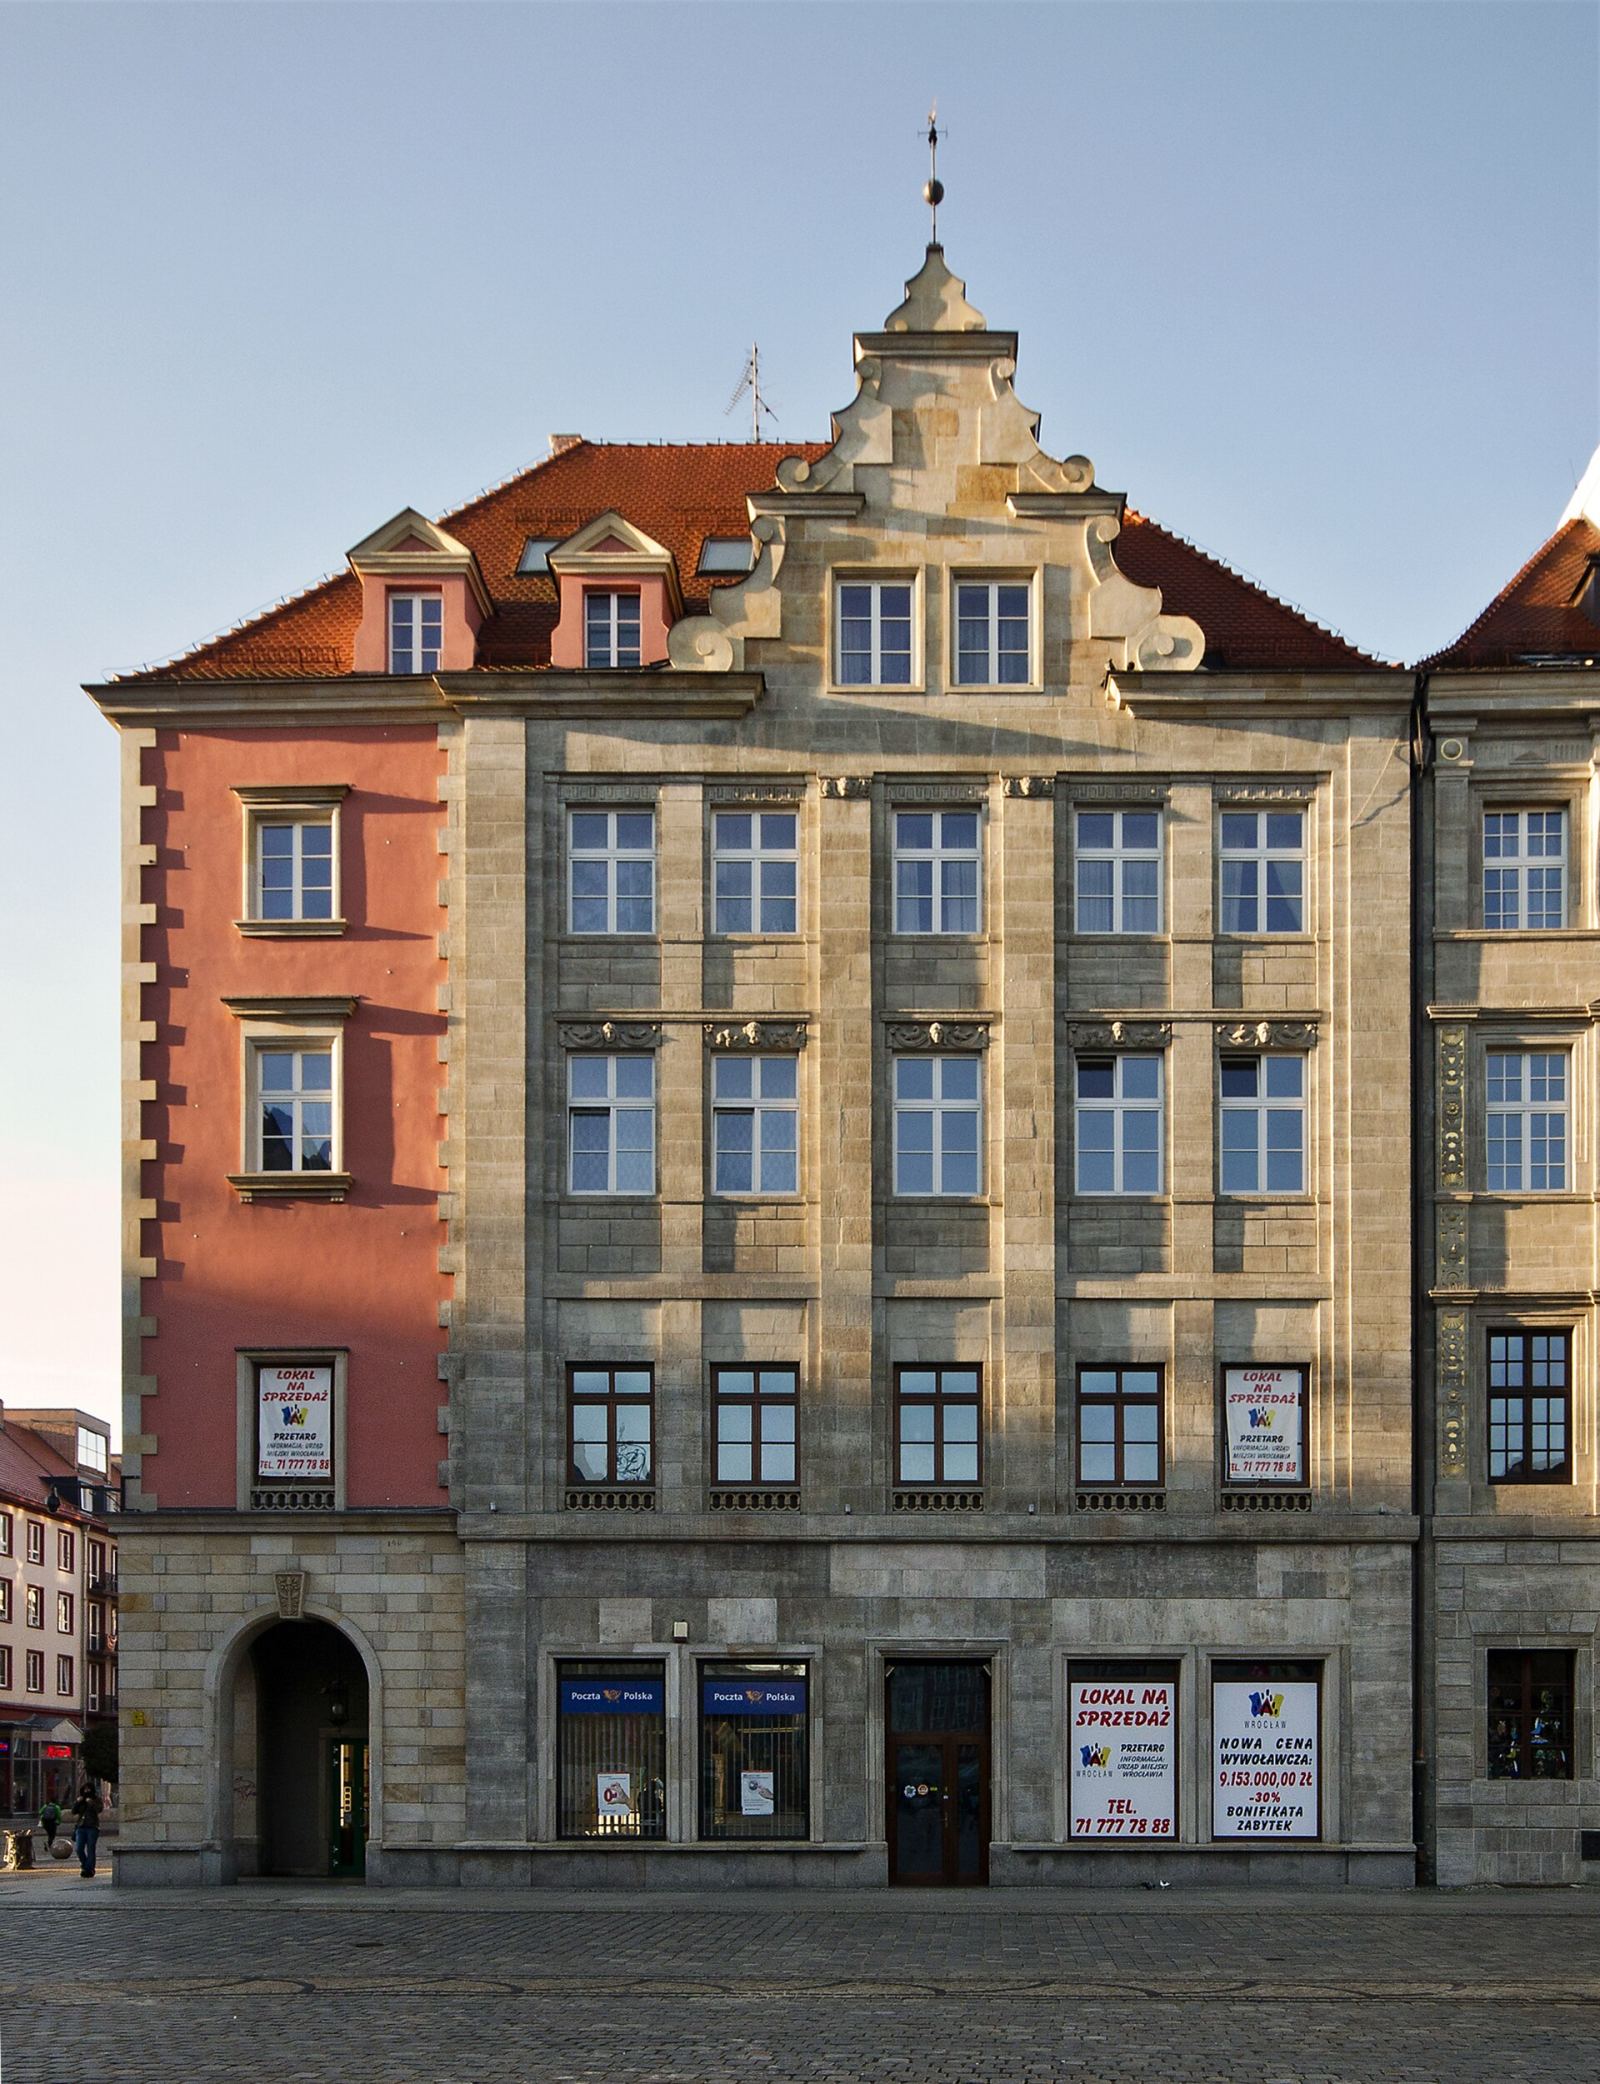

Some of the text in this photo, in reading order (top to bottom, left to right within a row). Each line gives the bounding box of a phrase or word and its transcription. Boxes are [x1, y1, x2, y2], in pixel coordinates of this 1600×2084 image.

[277, 1370, 316, 1380] LOKAL
[1243, 1372, 1282, 1382] LOKAL
[286, 1382, 305, 1391] NA
[1253, 1384, 1272, 1393] NA
[262, 1390, 329, 1402] SPRZEDAŻ
[1228, 1392, 1296, 1404] SPRZEDAŻ
[273, 1433, 317, 1441] PRZETARG
[1240, 1435, 1284, 1443] PRZETARG
[276, 1459, 286, 1470] 71
[288, 1459, 305, 1470] 777
[306, 1459, 318, 1470] 78
[1243, 1461, 1252, 1472] 71
[1254, 1461, 1271, 1472] 777
[1272, 1461, 1284, 1472] 78
[571, 1692, 653, 1701] Poczta Polska
[714, 1693, 795, 1702] Poczta Polska
[1080, 1688, 1168, 1705] LOKAL NA
[1075, 1705, 1171, 1728] SPRZEDAŻ
[1243, 1720, 1287, 1729] WROCŁAW
[1120, 1743, 1166, 1753] PRZETARG
[1219, 1737, 1313, 1750] NOWA CENA
[1220, 1753, 1313, 1766] WYWOŁAWCZA:
[1076, 1770, 1113, 1778] WROCŁAW
[1122, 1770, 1164, 1778] WROCŁAWIA
[1219, 1771, 1313, 1789] 9.153.000,00 ZŁ
[1249, 1791, 1281, 1803] -30%
[1107, 1799, 1138, 1815] TEL.
[1226, 1806, 1304, 1818] BONIFIKATA
[1075, 1818, 1171, 1834] 71 777 78 88
[1236, 1820, 1293, 1832] ZABYTEK
